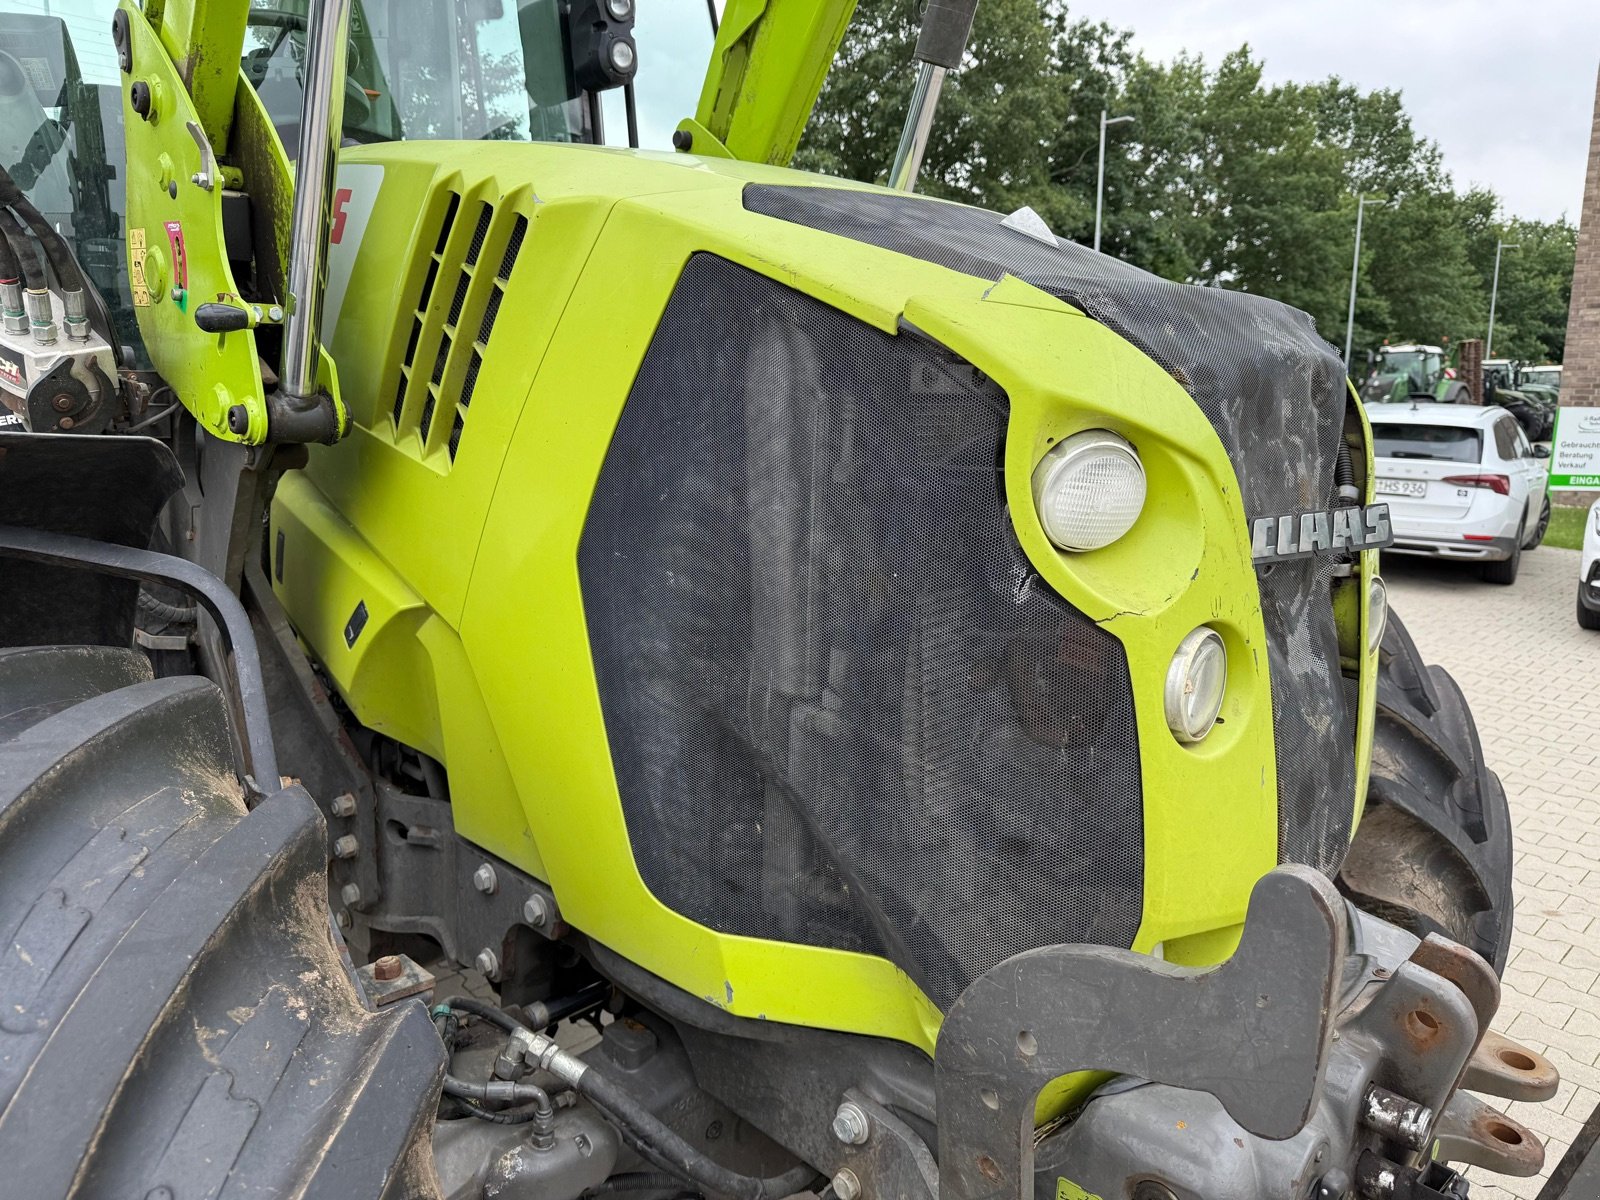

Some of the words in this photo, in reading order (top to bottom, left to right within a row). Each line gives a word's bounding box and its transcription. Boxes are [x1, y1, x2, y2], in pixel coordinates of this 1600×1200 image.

[1559, 452, 1593, 460] Beratung
[1402, 482, 1424, 494] 936
[1252, 505, 1389, 558] CLAAS
